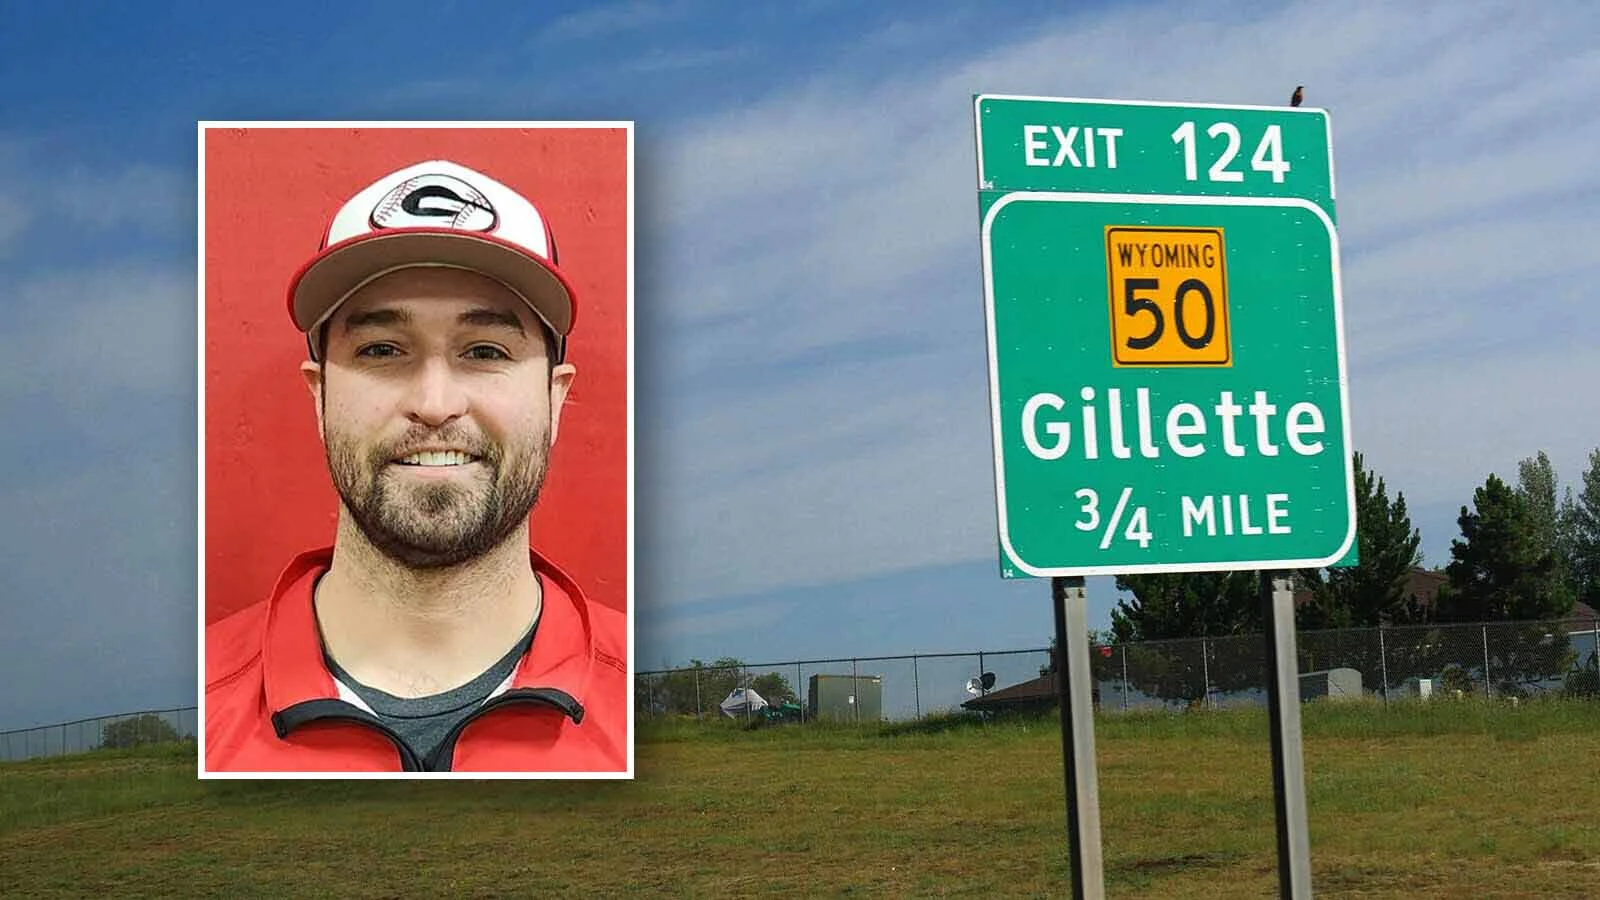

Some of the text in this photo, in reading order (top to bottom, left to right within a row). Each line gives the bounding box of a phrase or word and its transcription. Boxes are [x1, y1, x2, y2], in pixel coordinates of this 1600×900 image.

[1023, 121, 1291, 183] EXIT 124
[1117, 242, 1215, 269] WYOMING
[1123, 277, 1216, 350] 50
[1021, 386, 1326, 460] Gillette
[1074, 487, 1292, 549] 3/4 MILE
